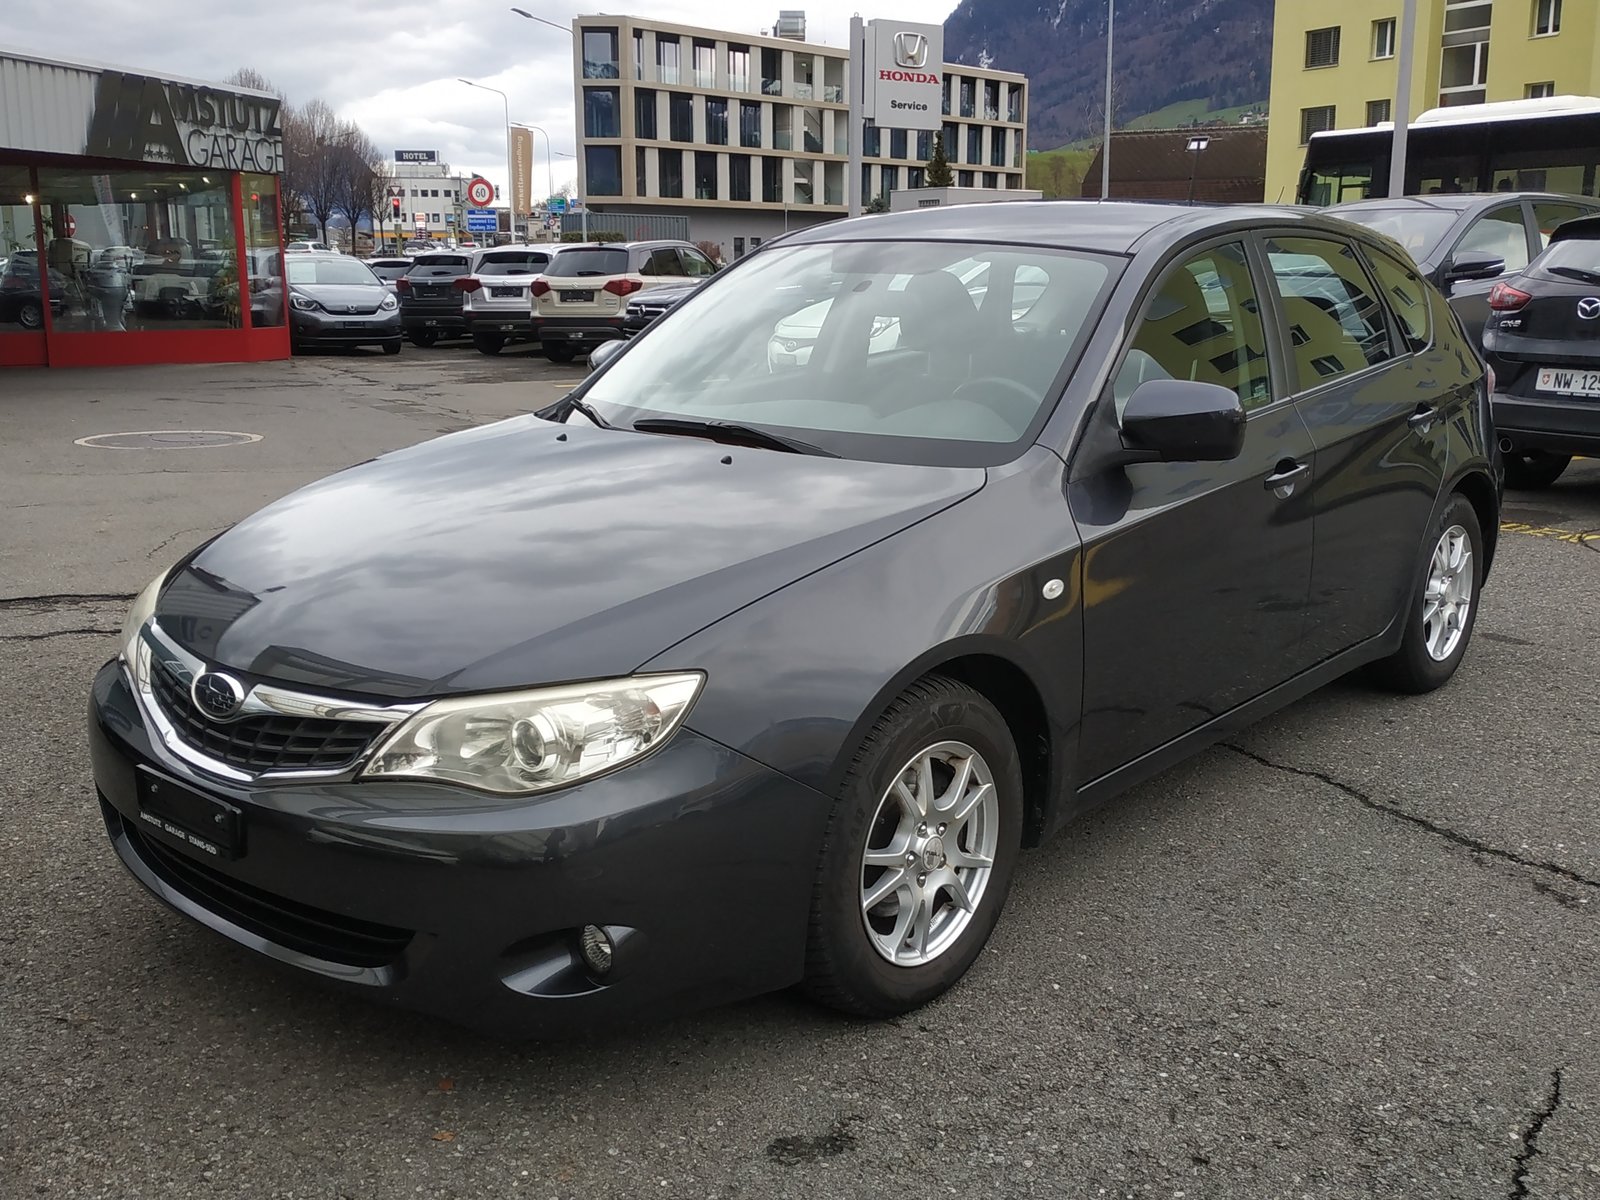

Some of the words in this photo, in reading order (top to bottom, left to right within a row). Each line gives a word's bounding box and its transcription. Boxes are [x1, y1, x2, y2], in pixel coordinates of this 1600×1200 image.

[879, 70, 940, 84] HONDA
[890, 99, 928, 111] Service
[142, 76, 282, 165] AMSTUTZ
[187, 128, 285, 174] GARAGE
[402, 152, 429, 160] HOTEL
[475, 187, 486, 198] 60
[1553, 372, 1574, 389] NW
[140, 811, 162, 828] AMSTUTZ
[164, 823, 186, 840] GARAGE
